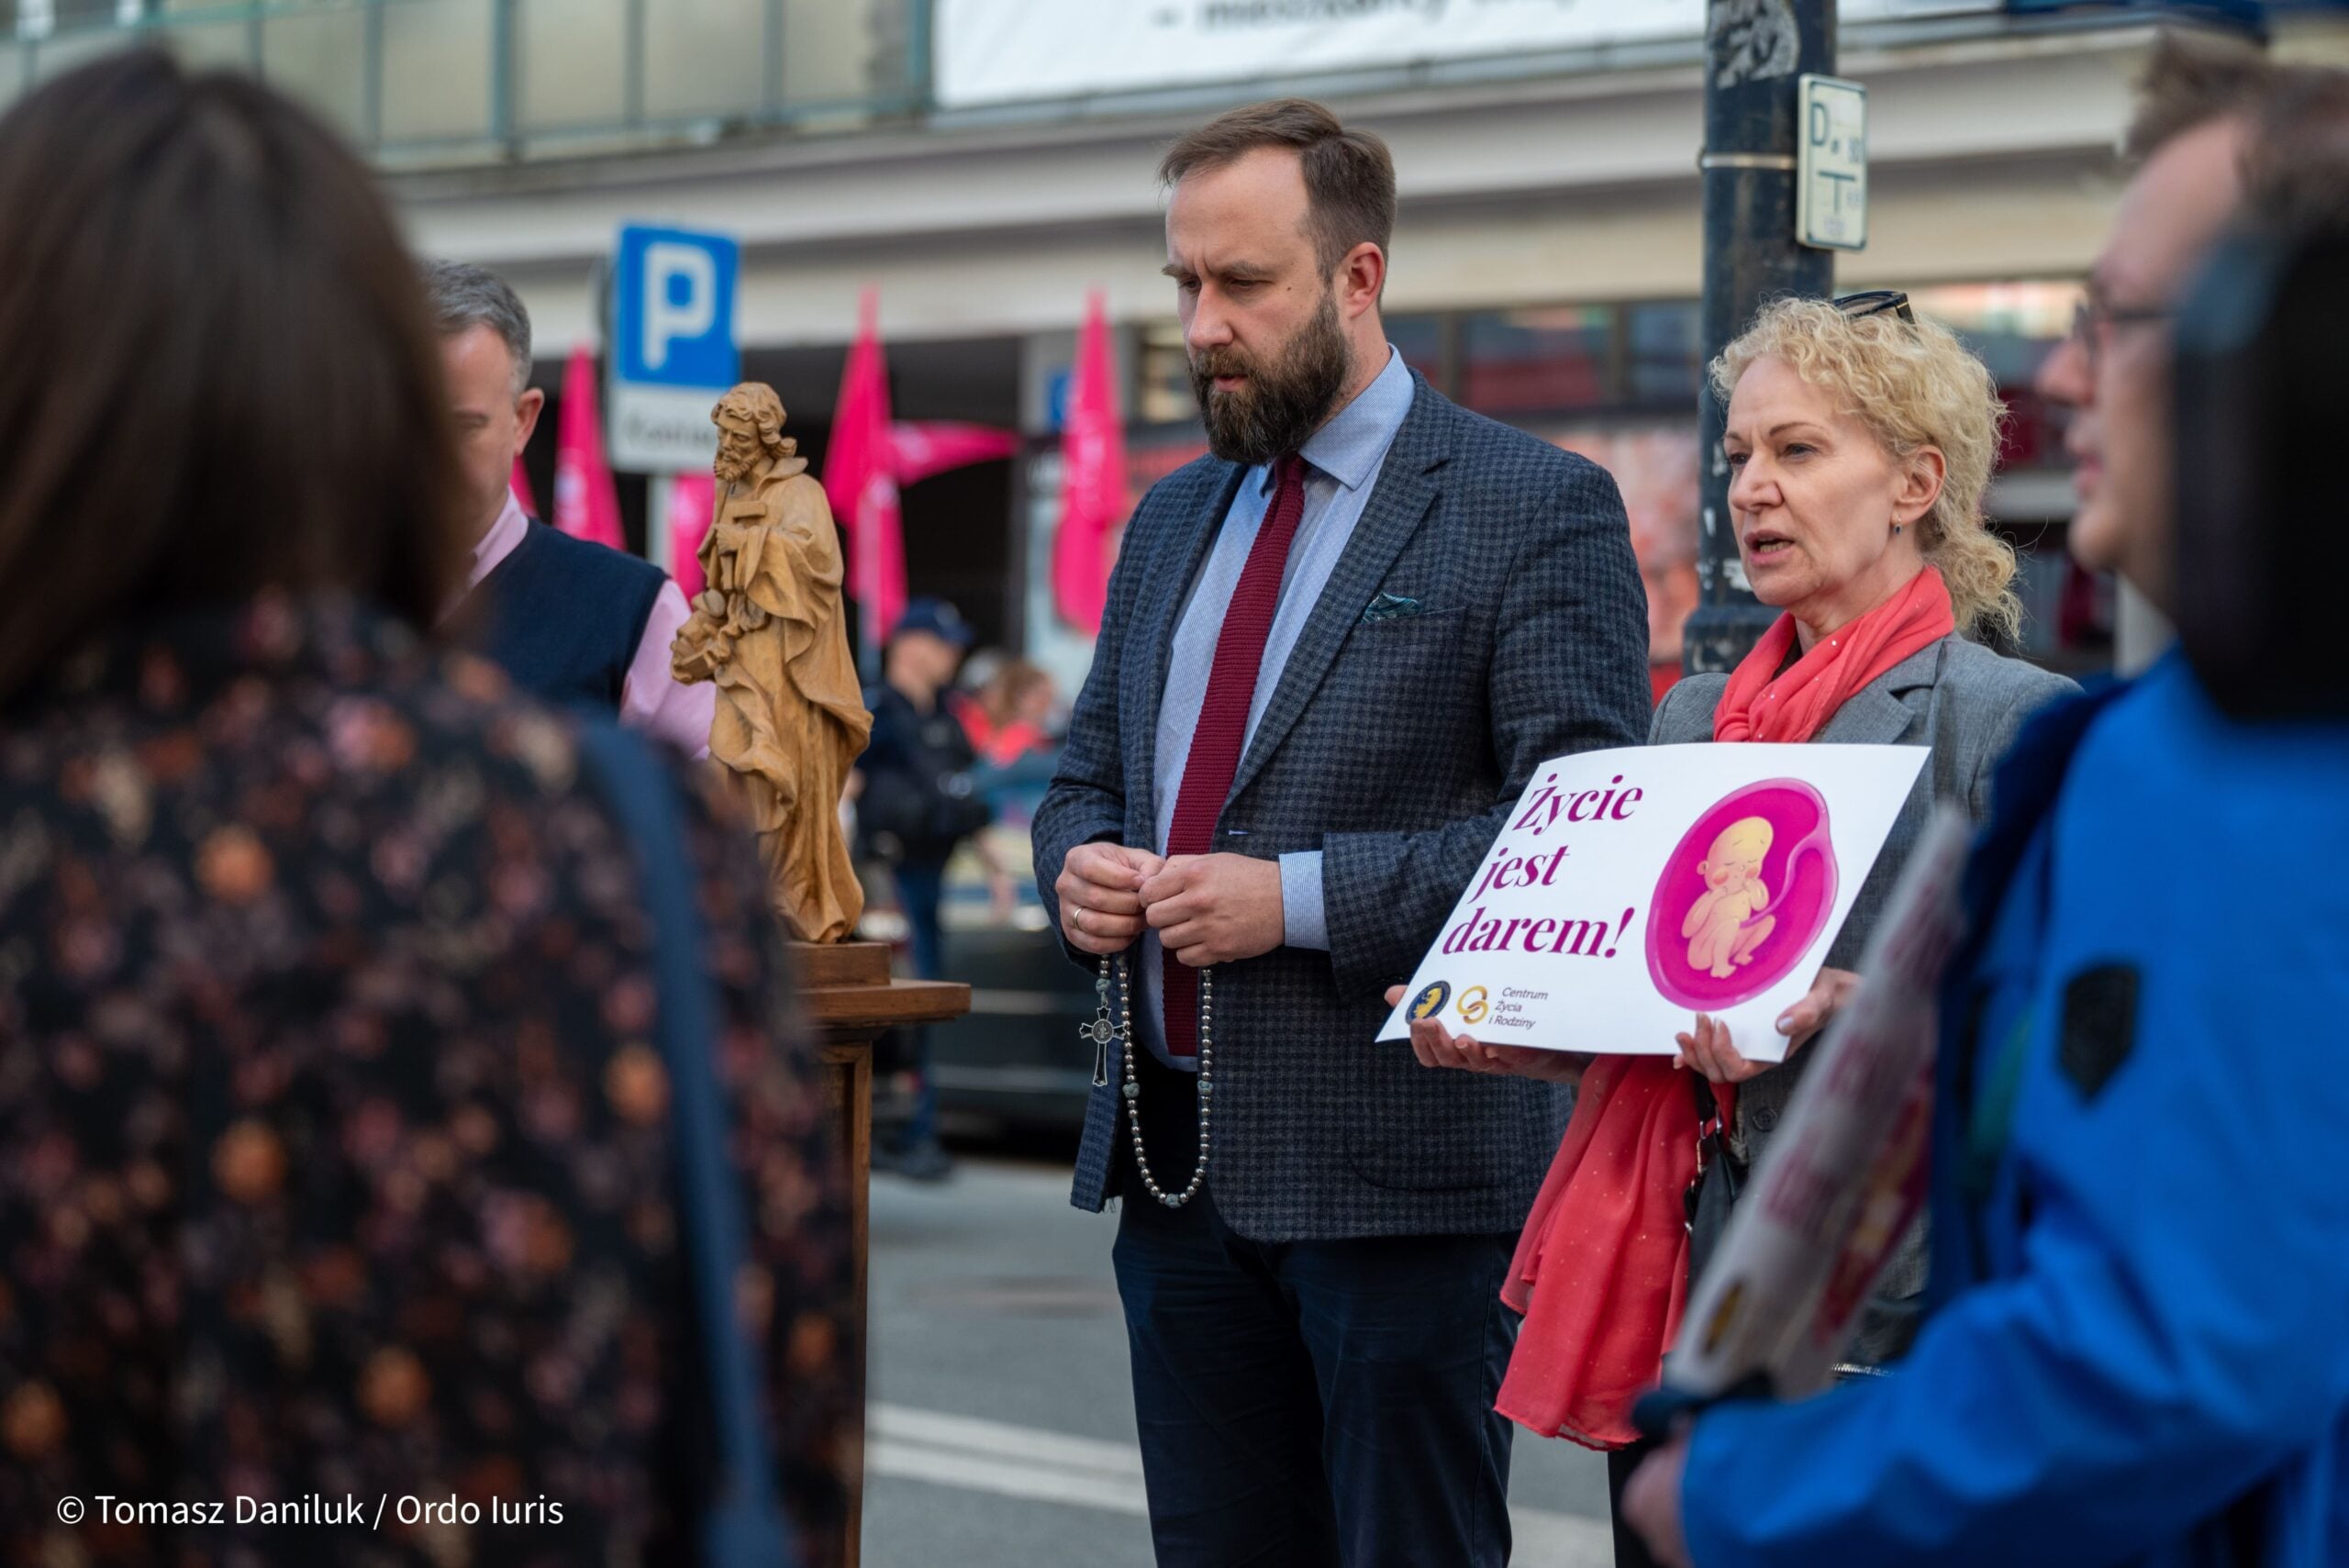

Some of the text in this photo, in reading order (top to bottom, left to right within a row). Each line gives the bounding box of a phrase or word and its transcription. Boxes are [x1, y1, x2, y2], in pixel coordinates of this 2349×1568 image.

[641, 241, 718, 371] P
[1512, 773, 1643, 836] Życie
[1467, 845, 1570, 905] jest
[1442, 906, 1636, 959] darem!
[1494, 1000, 1523, 1014] Życia
[1501, 986, 1549, 1001] Centrum
[1494, 1015, 1537, 1031] Rodziny
